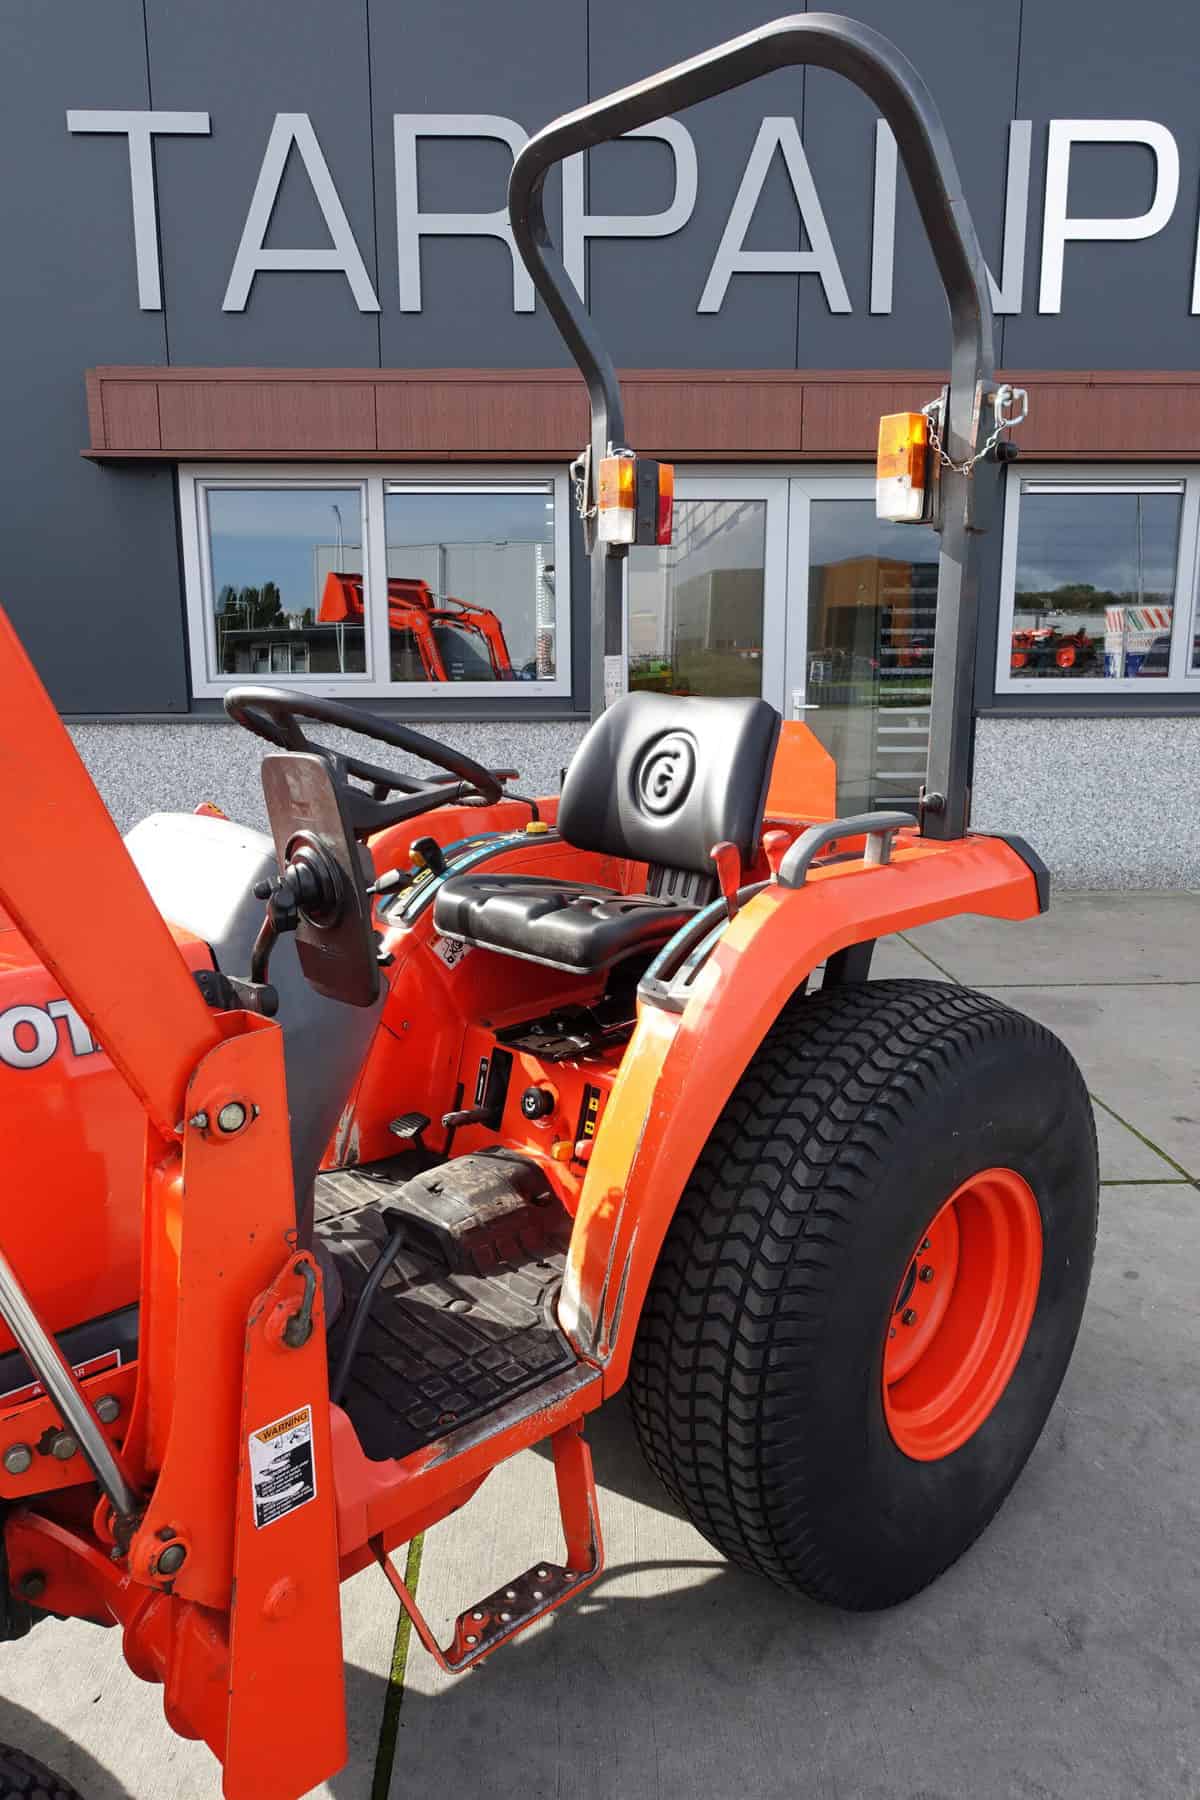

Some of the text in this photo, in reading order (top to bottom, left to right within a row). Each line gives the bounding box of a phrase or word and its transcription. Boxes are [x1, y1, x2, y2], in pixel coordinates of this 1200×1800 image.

[66, 109, 1200, 314] TARPANP
[0, 998, 103, 1070] OT
[263, 1411, 307, 1440] WARNING
